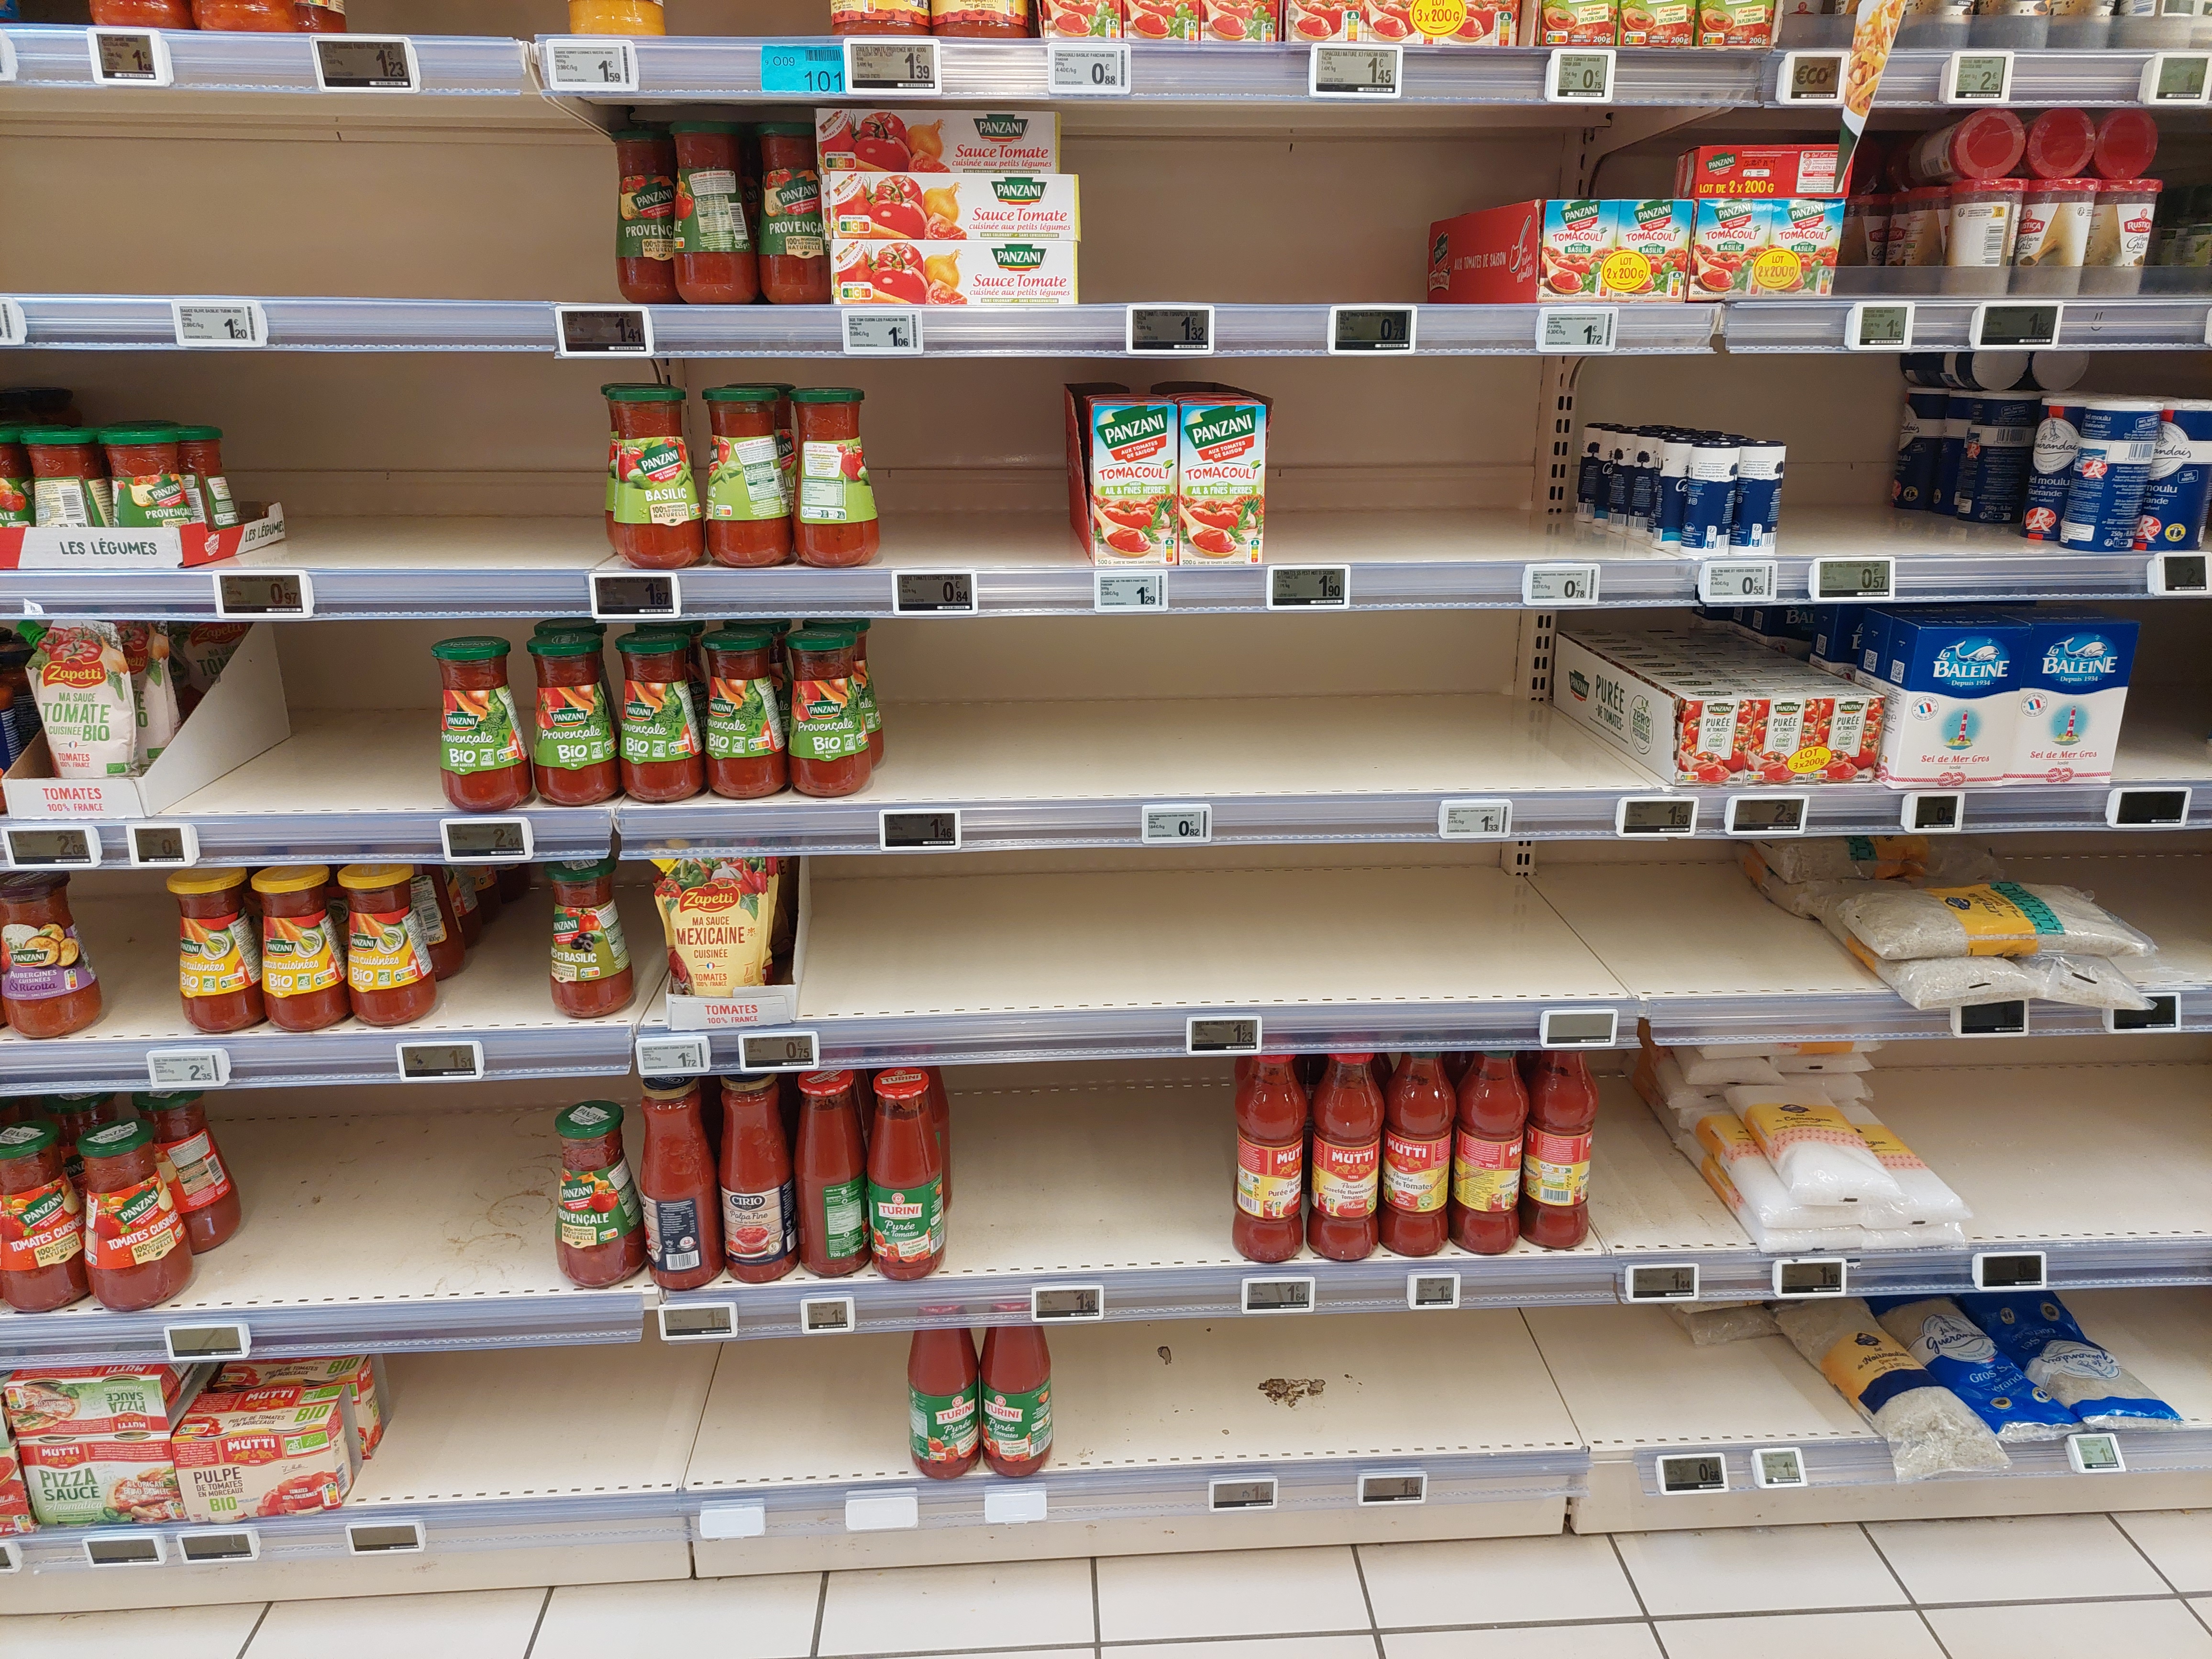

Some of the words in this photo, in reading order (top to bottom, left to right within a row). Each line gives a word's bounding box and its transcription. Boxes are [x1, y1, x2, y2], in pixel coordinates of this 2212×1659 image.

[1749, 37, 1766, 45] 200g
[804, 70, 843, 91] 101
[956, 144, 997, 158] Sauce
[999, 145, 1049, 158] Tomate
[781, 185, 816, 203] PANZANI
[973, 208, 1014, 221] Sauce
[1016, 208, 1067, 221] Tomate
[1017, 223, 1038, 231] petits
[1040, 223, 1071, 231] légumes
[1454, 258, 1462, 270] AUX
[1463, 255, 1482, 269] TOMATES
[1483, 254, 1488, 267] DE
[1620, 257, 1632, 266] LOT
[1772, 255, 1783, 264] LOT
[973, 275, 1014, 288] Sauce
[1016, 275, 1066, 288] Tomate
[1017, 289, 1038, 297] petits
[1040, 289, 1070, 297] légumes
[1193, 414, 1252, 443] PANZANI
[1221, 441, 1245, 452] TOMATES
[645, 488, 686, 502] BASILIC
[1124, 487, 1141, 495] FINES
[1143, 486, 1166, 494] HERBES
[1211, 487, 1227, 495] FINES
[245, 527, 256, 542] LES
[59, 541, 86, 555] LES
[92, 538, 157, 555] LÉGUMES
[1933, 660, 2009, 677] BALEINE
[2043, 656, 2117, 674] BALEINE
[47, 665, 101, 681] Zapetti
[59, 692, 71, 701] MA
[73, 693, 95, 702] SAUCE
[42, 702, 111, 724] TOMATE
[448, 718, 476, 726] PANZANI
[798, 719, 854, 733] Provençale
[1706, 717, 1730, 727] PURÉE
[1773, 717, 1797, 726] PURÉE
[1836, 716, 1860, 725] PURÉE
[49, 725, 82, 735] CUISINÉE
[83, 725, 111, 742] BIO
[542, 725, 601, 740] Provençale
[1799, 748, 1818, 760] LOT
[1921, 754, 1934, 763] Sel
[1937, 754, 1947, 763] de
[1950, 754, 1970, 763] Mer
[42, 787, 102, 800] TOMATES
[683, 892, 734, 907] Zapetti
[693, 917, 704, 926] MA
[706, 917, 730, 925] SAUCE
[676, 927, 745, 945] MEXICAINE
[694, 947, 728, 958] CUISINÉE
[278, 959, 319, 970] cuisinées
[360, 956, 398, 966] cuisinées
[10, 970, 56, 978] AUBERGINES
[9, 982, 18, 991] &
[19, 982, 57, 991] Ricotta
[705, 1005, 758, 1015] TOMATES
[1387, 1138, 1427, 1158] MUTTI
[1331, 1150, 1374, 1164] MUTTI
[731, 1196, 763, 1206] CIRIO
[24, 1193, 63, 1224] PANZANI
[880, 1205, 920, 1215] TURINI
[885, 1220, 915, 1231] Purée
[891, 1229, 919, 1238] Tomates
[1969, 1369, 1991, 1385] Gros
[245, 1390, 295, 1402] MUTTI
[294, 1404, 330, 1423] BIO
[939, 1401, 973, 1421] TURINI
[986, 1403, 1019, 1418] TURINI
[944, 1419, 971, 1434] Purée
[227, 1438, 275, 1451] MUTTI
[38, 1467, 97, 1488] PIZZA
[193, 1467, 241, 1484] PULPE
[208, 1480, 243, 1490] TOMATES
[44, 1486, 100, 1501] SAUCE
[208, 1487, 244, 1497] MORCEAUX
[210, 1496, 238, 1512] BIO
